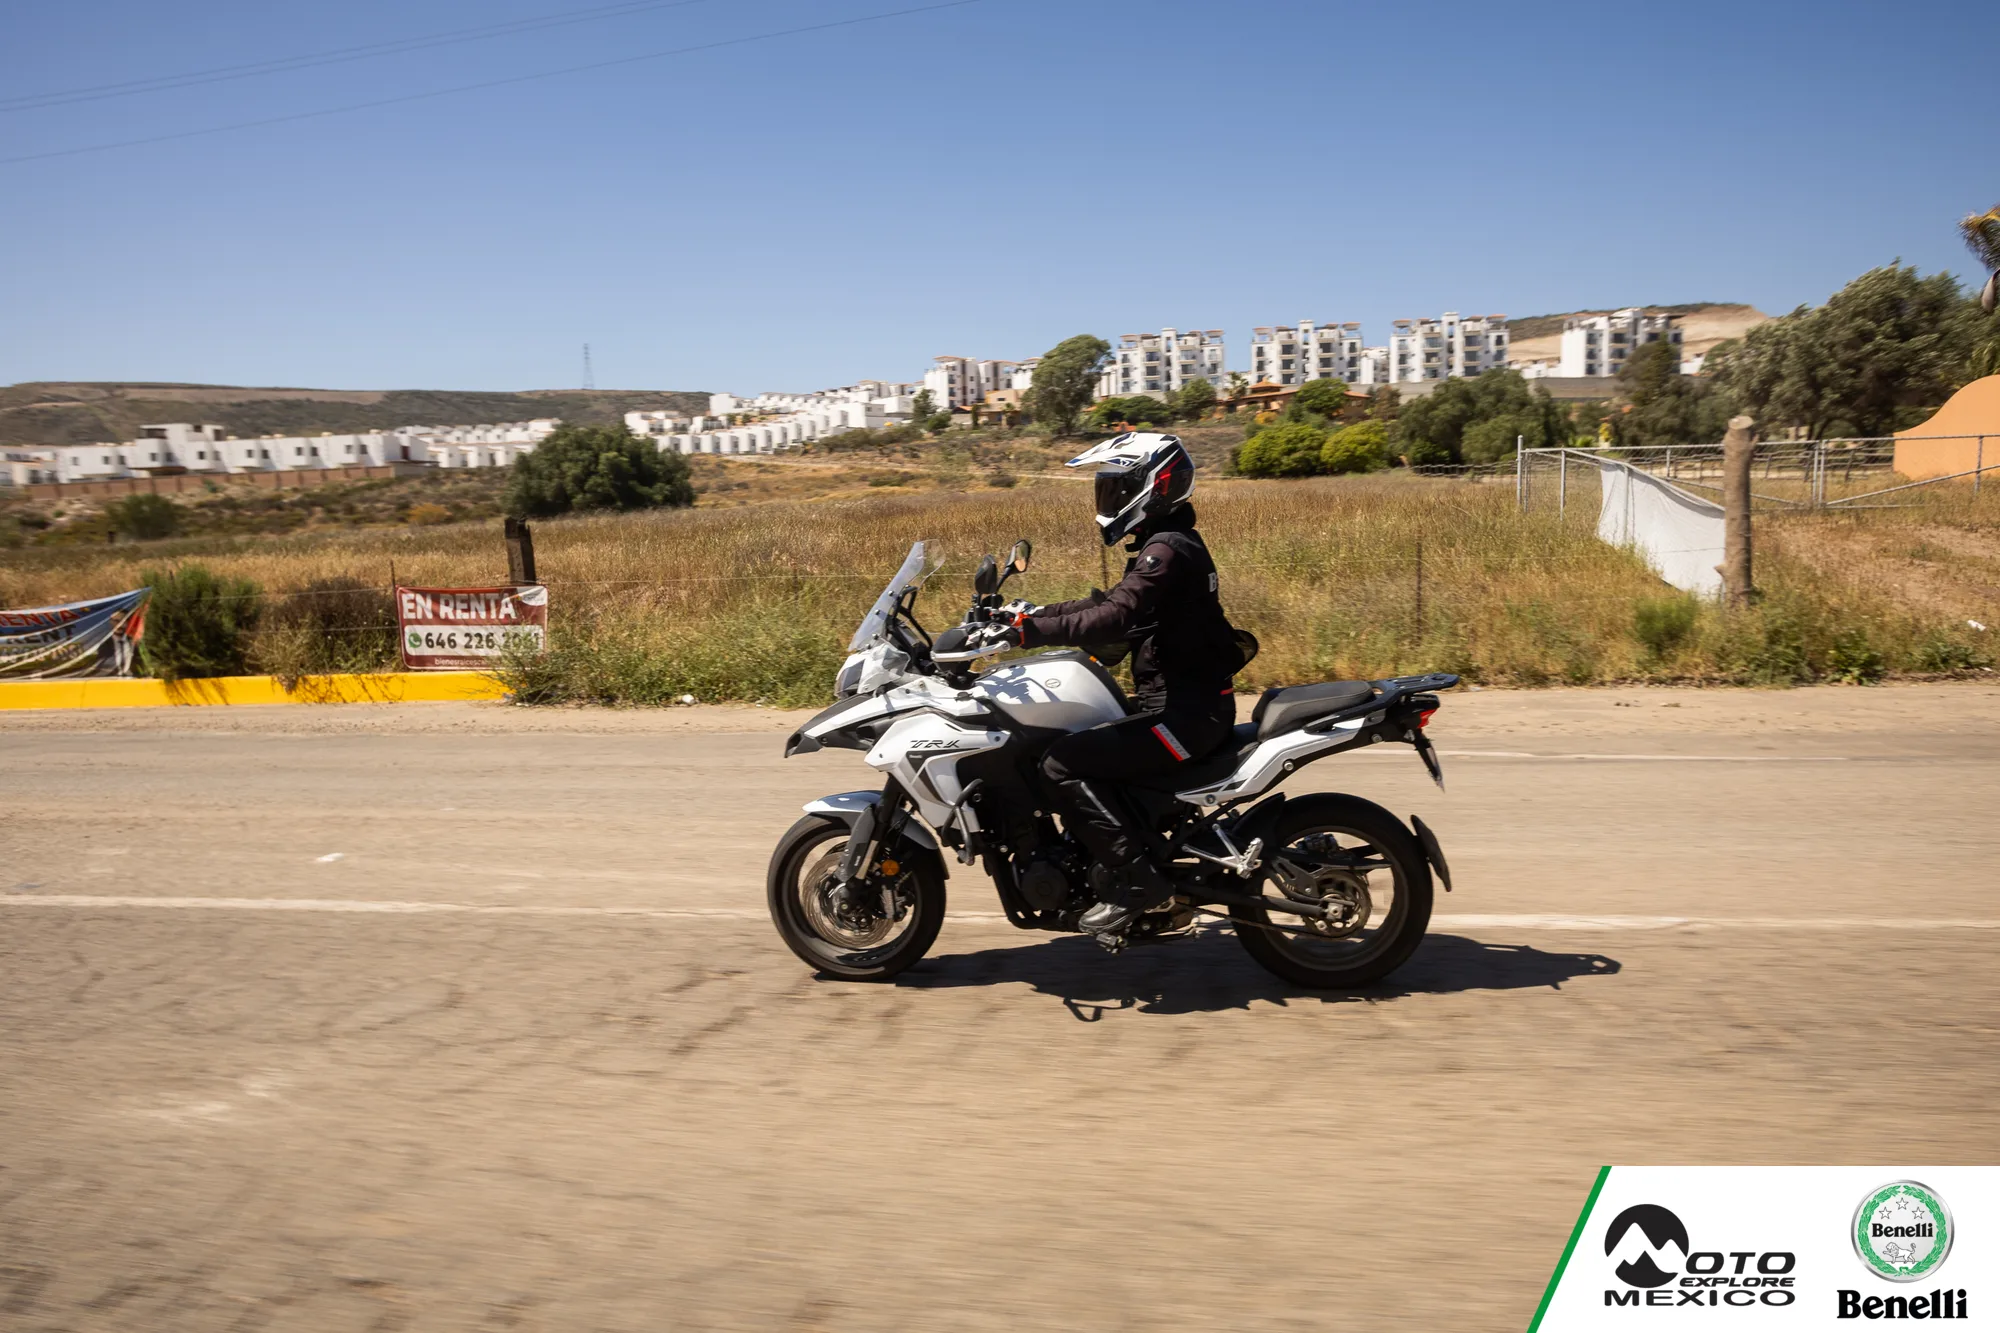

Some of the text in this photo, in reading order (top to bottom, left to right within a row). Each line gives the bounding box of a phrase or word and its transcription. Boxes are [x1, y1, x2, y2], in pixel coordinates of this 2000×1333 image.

[401, 593, 517, 620] EN RENTA
[425, 632, 457, 649] 646
[464, 632, 495, 649] 226
[910, 739, 960, 749] TRK
